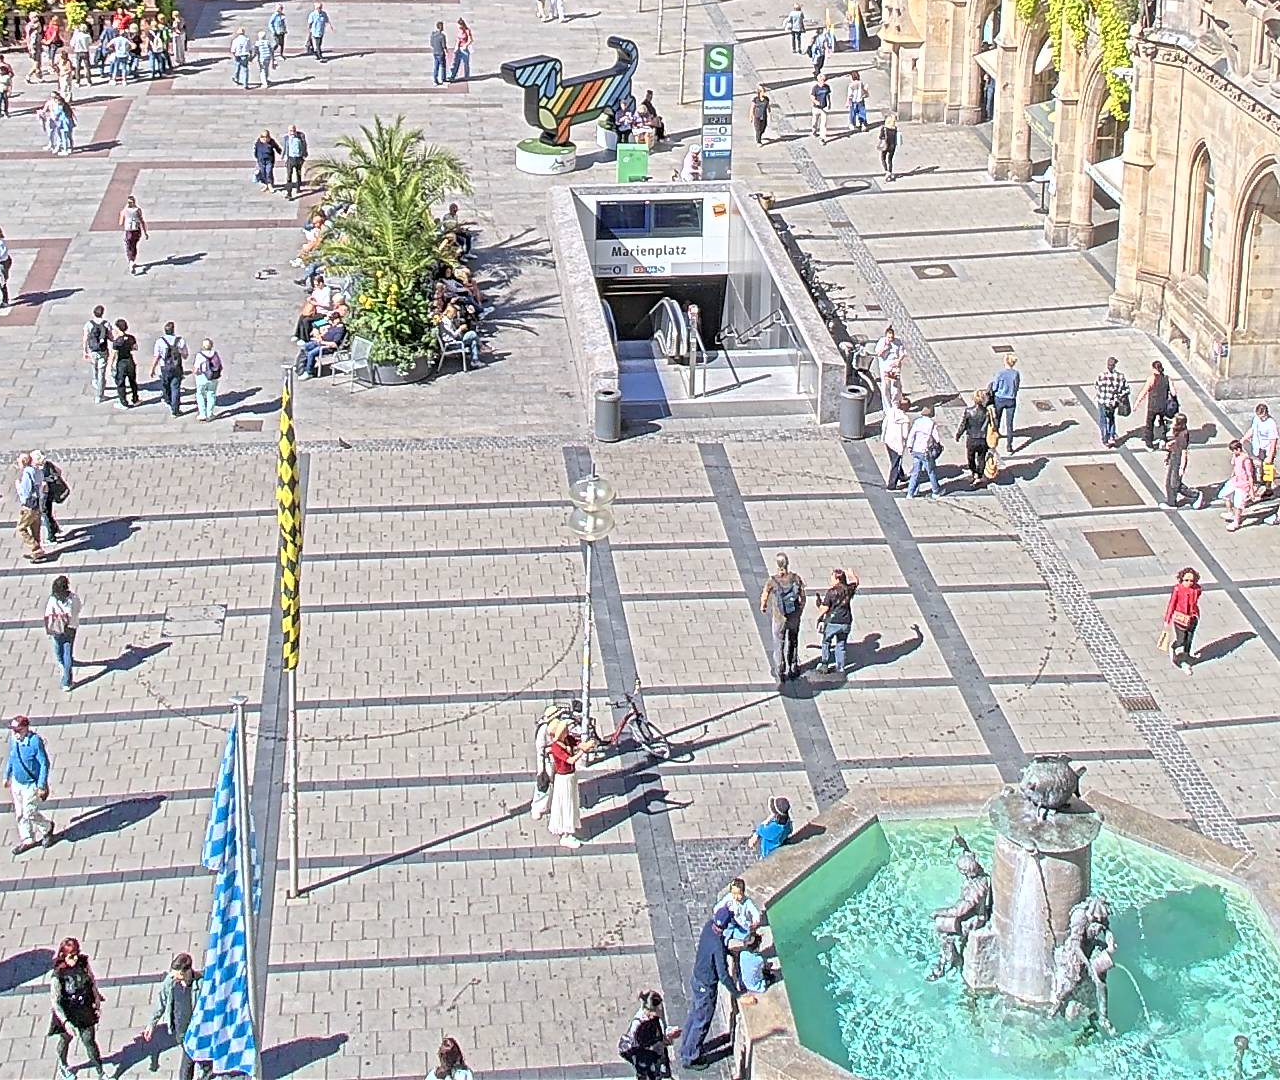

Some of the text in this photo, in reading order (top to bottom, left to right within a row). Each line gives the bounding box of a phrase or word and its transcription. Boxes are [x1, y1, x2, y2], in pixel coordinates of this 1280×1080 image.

[709, 47, 729, 70] S
[709, 76, 727, 97] U
[611, 245, 687, 258] Marienplatz
